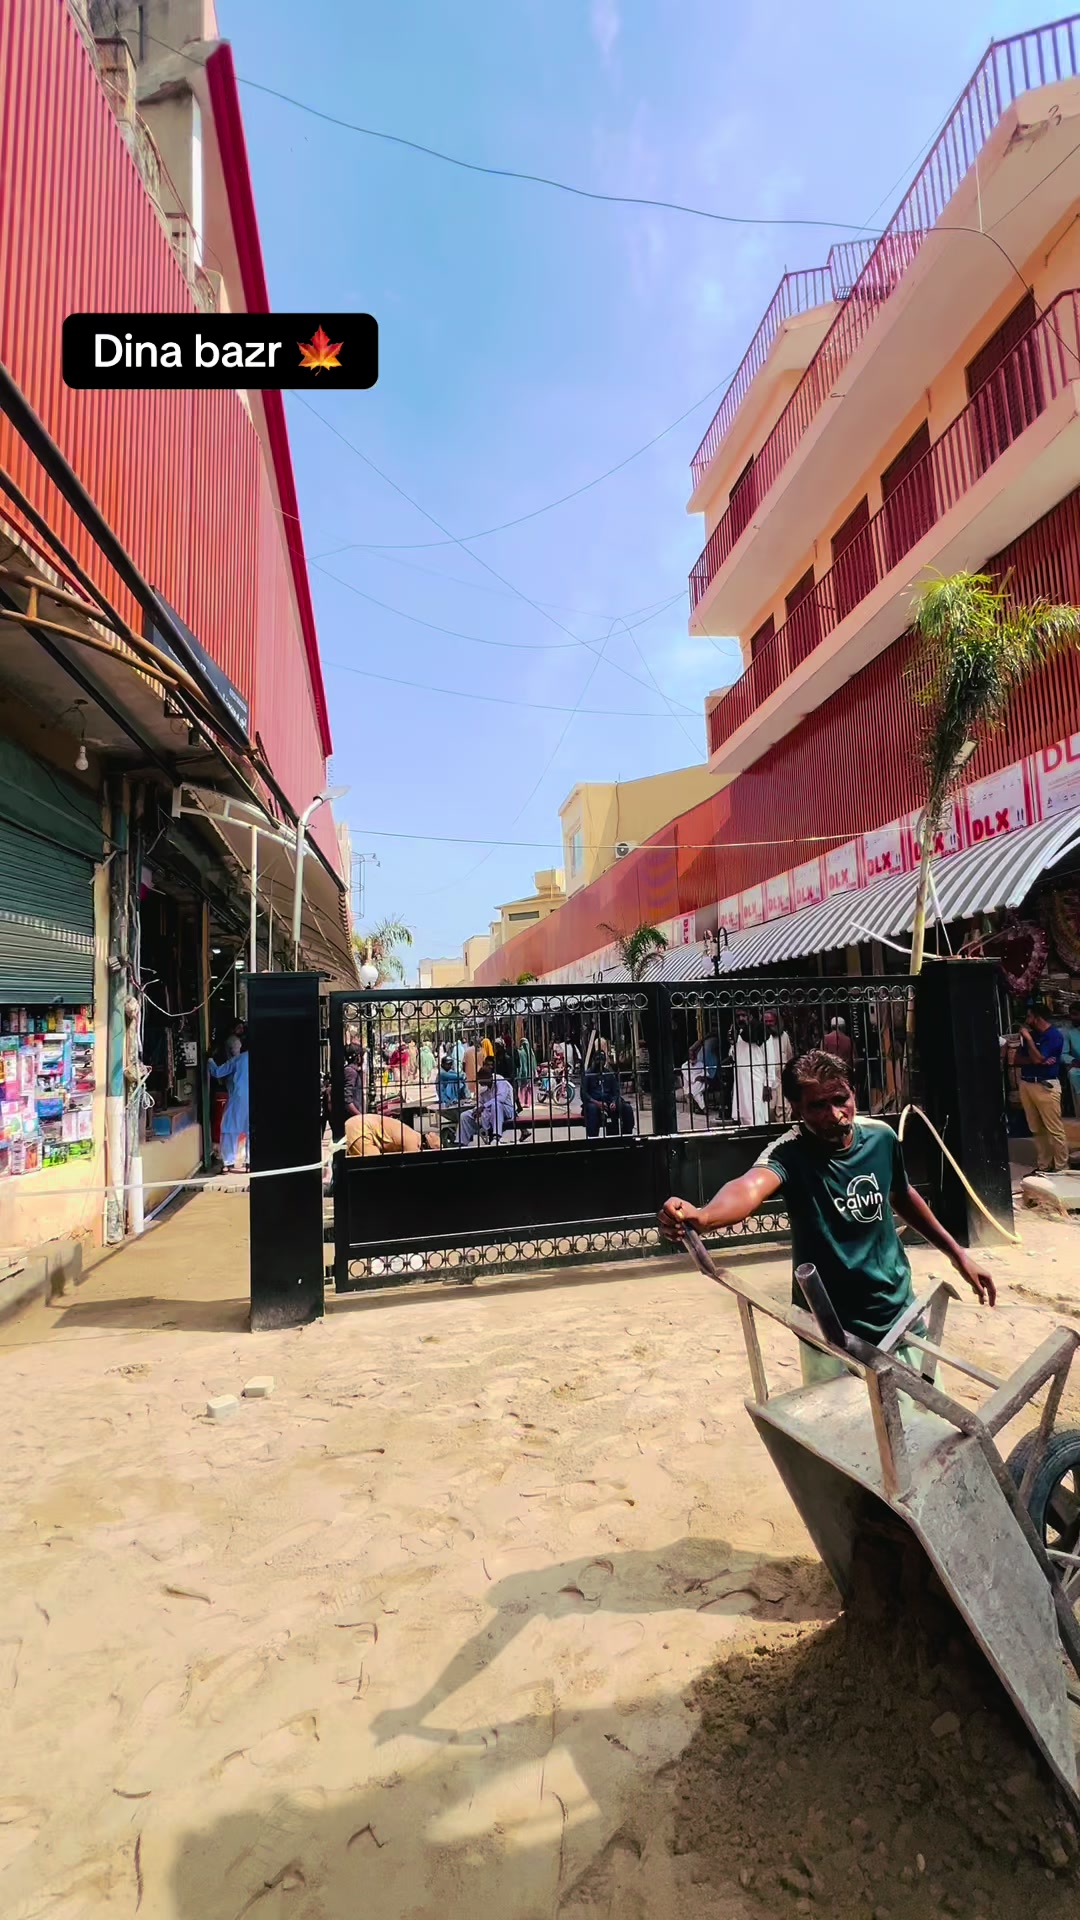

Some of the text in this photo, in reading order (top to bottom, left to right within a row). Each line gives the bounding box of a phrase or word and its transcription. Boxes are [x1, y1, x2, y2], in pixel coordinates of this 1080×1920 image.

[972, 808, 1011, 841] DLX
[913, 831, 945, 861] DX
[867, 851, 892, 877] DLX
[829, 868, 849, 891] DLX
[833, 1190, 883, 1212] Calvin
